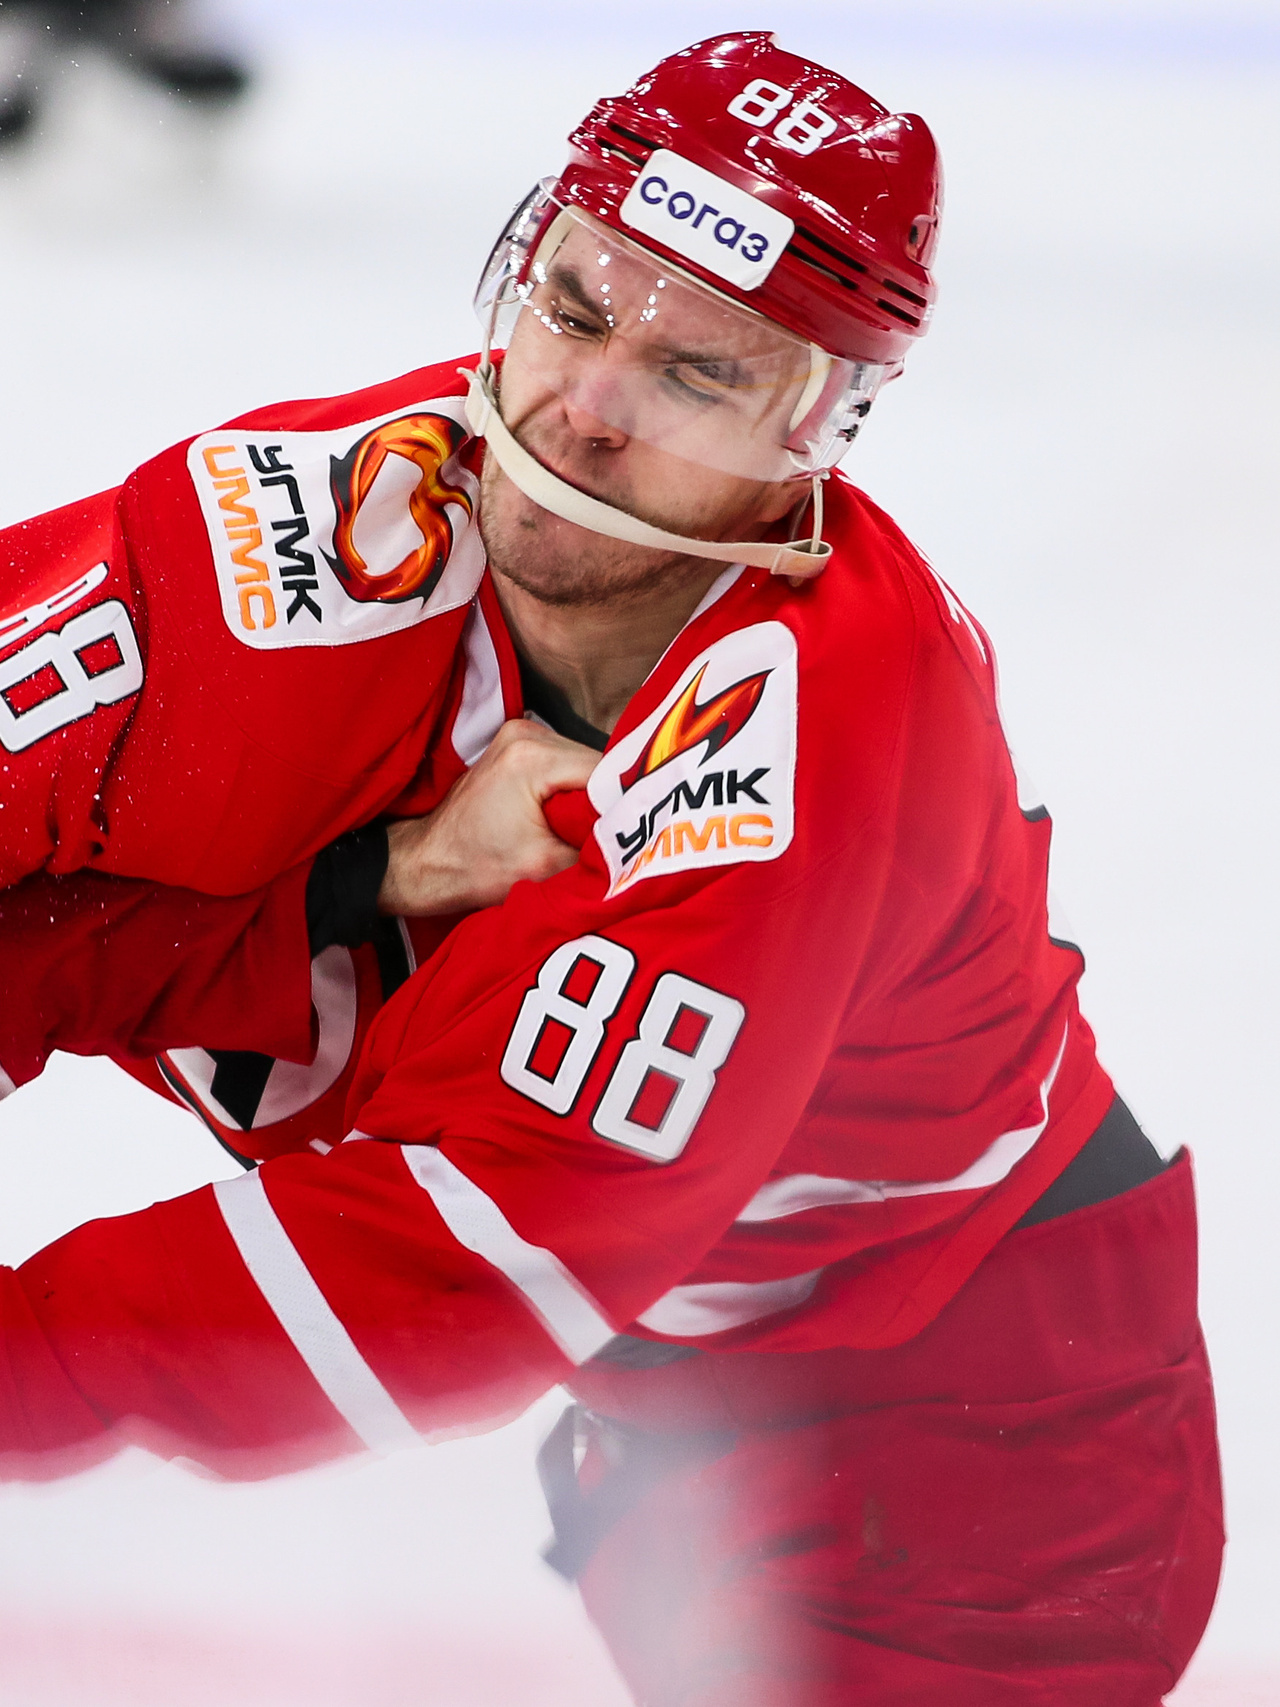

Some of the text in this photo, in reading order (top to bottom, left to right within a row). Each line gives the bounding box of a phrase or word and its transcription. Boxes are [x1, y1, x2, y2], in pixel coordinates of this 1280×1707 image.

[726, 77, 839, 156] 88
[201, 444, 277, 632] UMMC
[245, 443, 324, 626] УГМК
[499, 933, 746, 1165] 88
